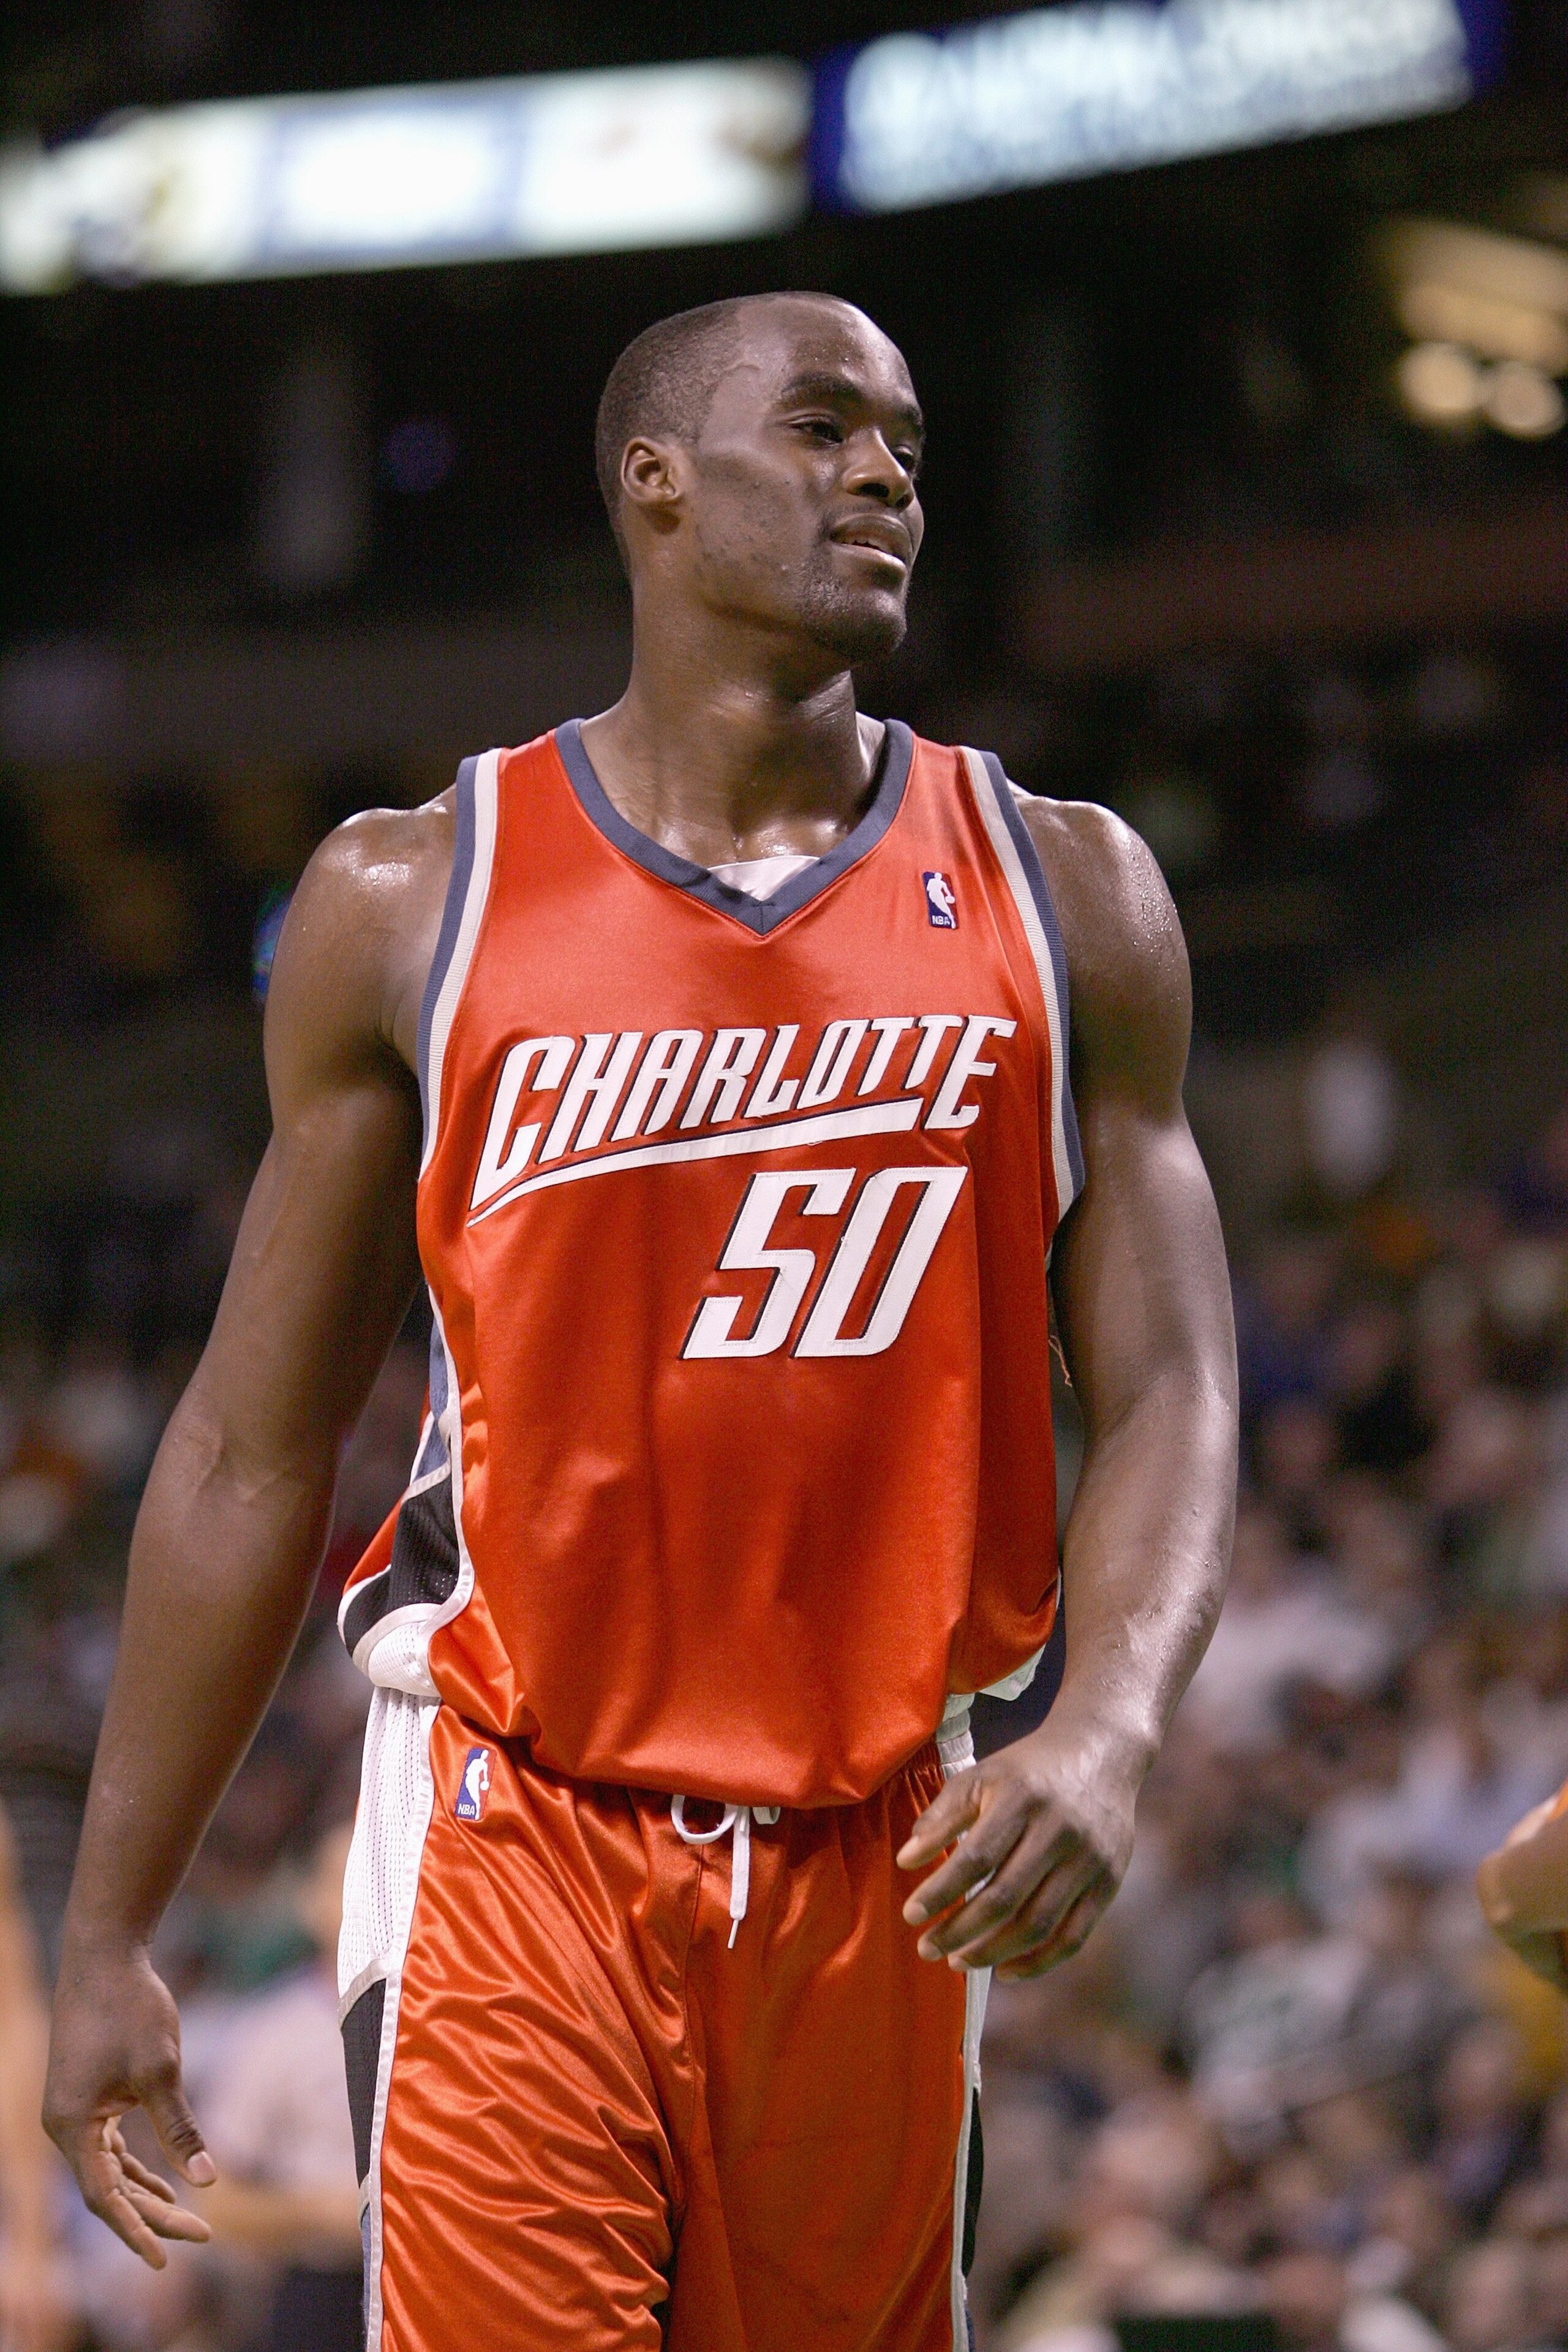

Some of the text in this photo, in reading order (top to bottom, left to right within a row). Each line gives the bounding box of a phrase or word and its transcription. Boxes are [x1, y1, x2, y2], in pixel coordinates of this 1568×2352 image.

[932, 916, 950, 925] NBA
[470, 1014, 1017, 1210] CHARLOTTE
[679, 1166, 968, 1359] 50
[458, 1804, 475, 1815] NBA
